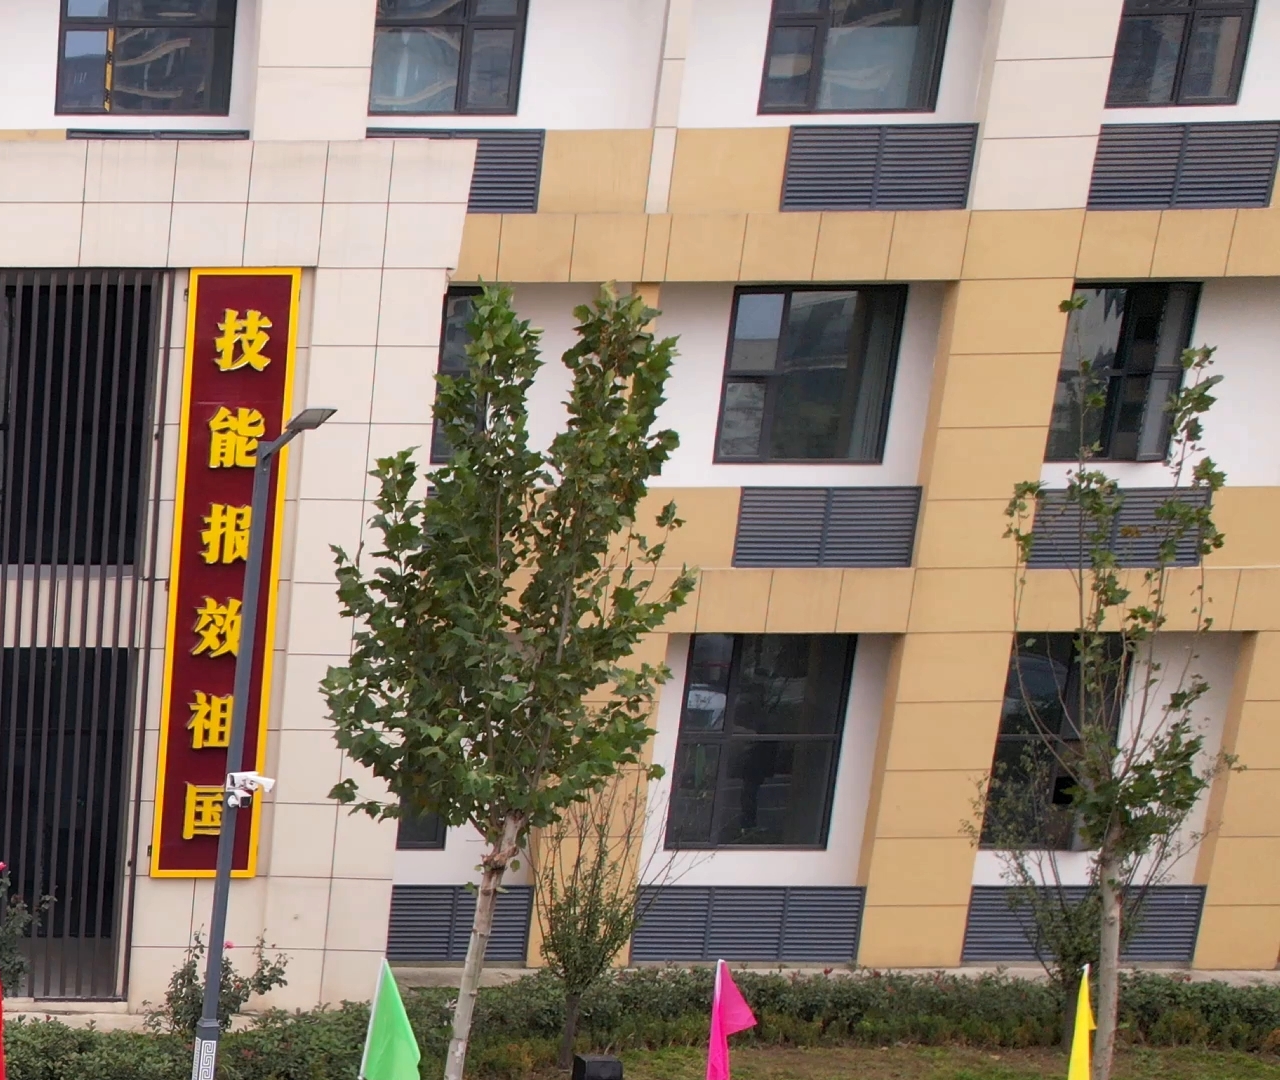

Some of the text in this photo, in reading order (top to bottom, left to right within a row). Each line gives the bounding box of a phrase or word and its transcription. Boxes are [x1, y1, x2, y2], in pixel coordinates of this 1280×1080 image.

[182, 308, 271, 840] 技能报效祖国
